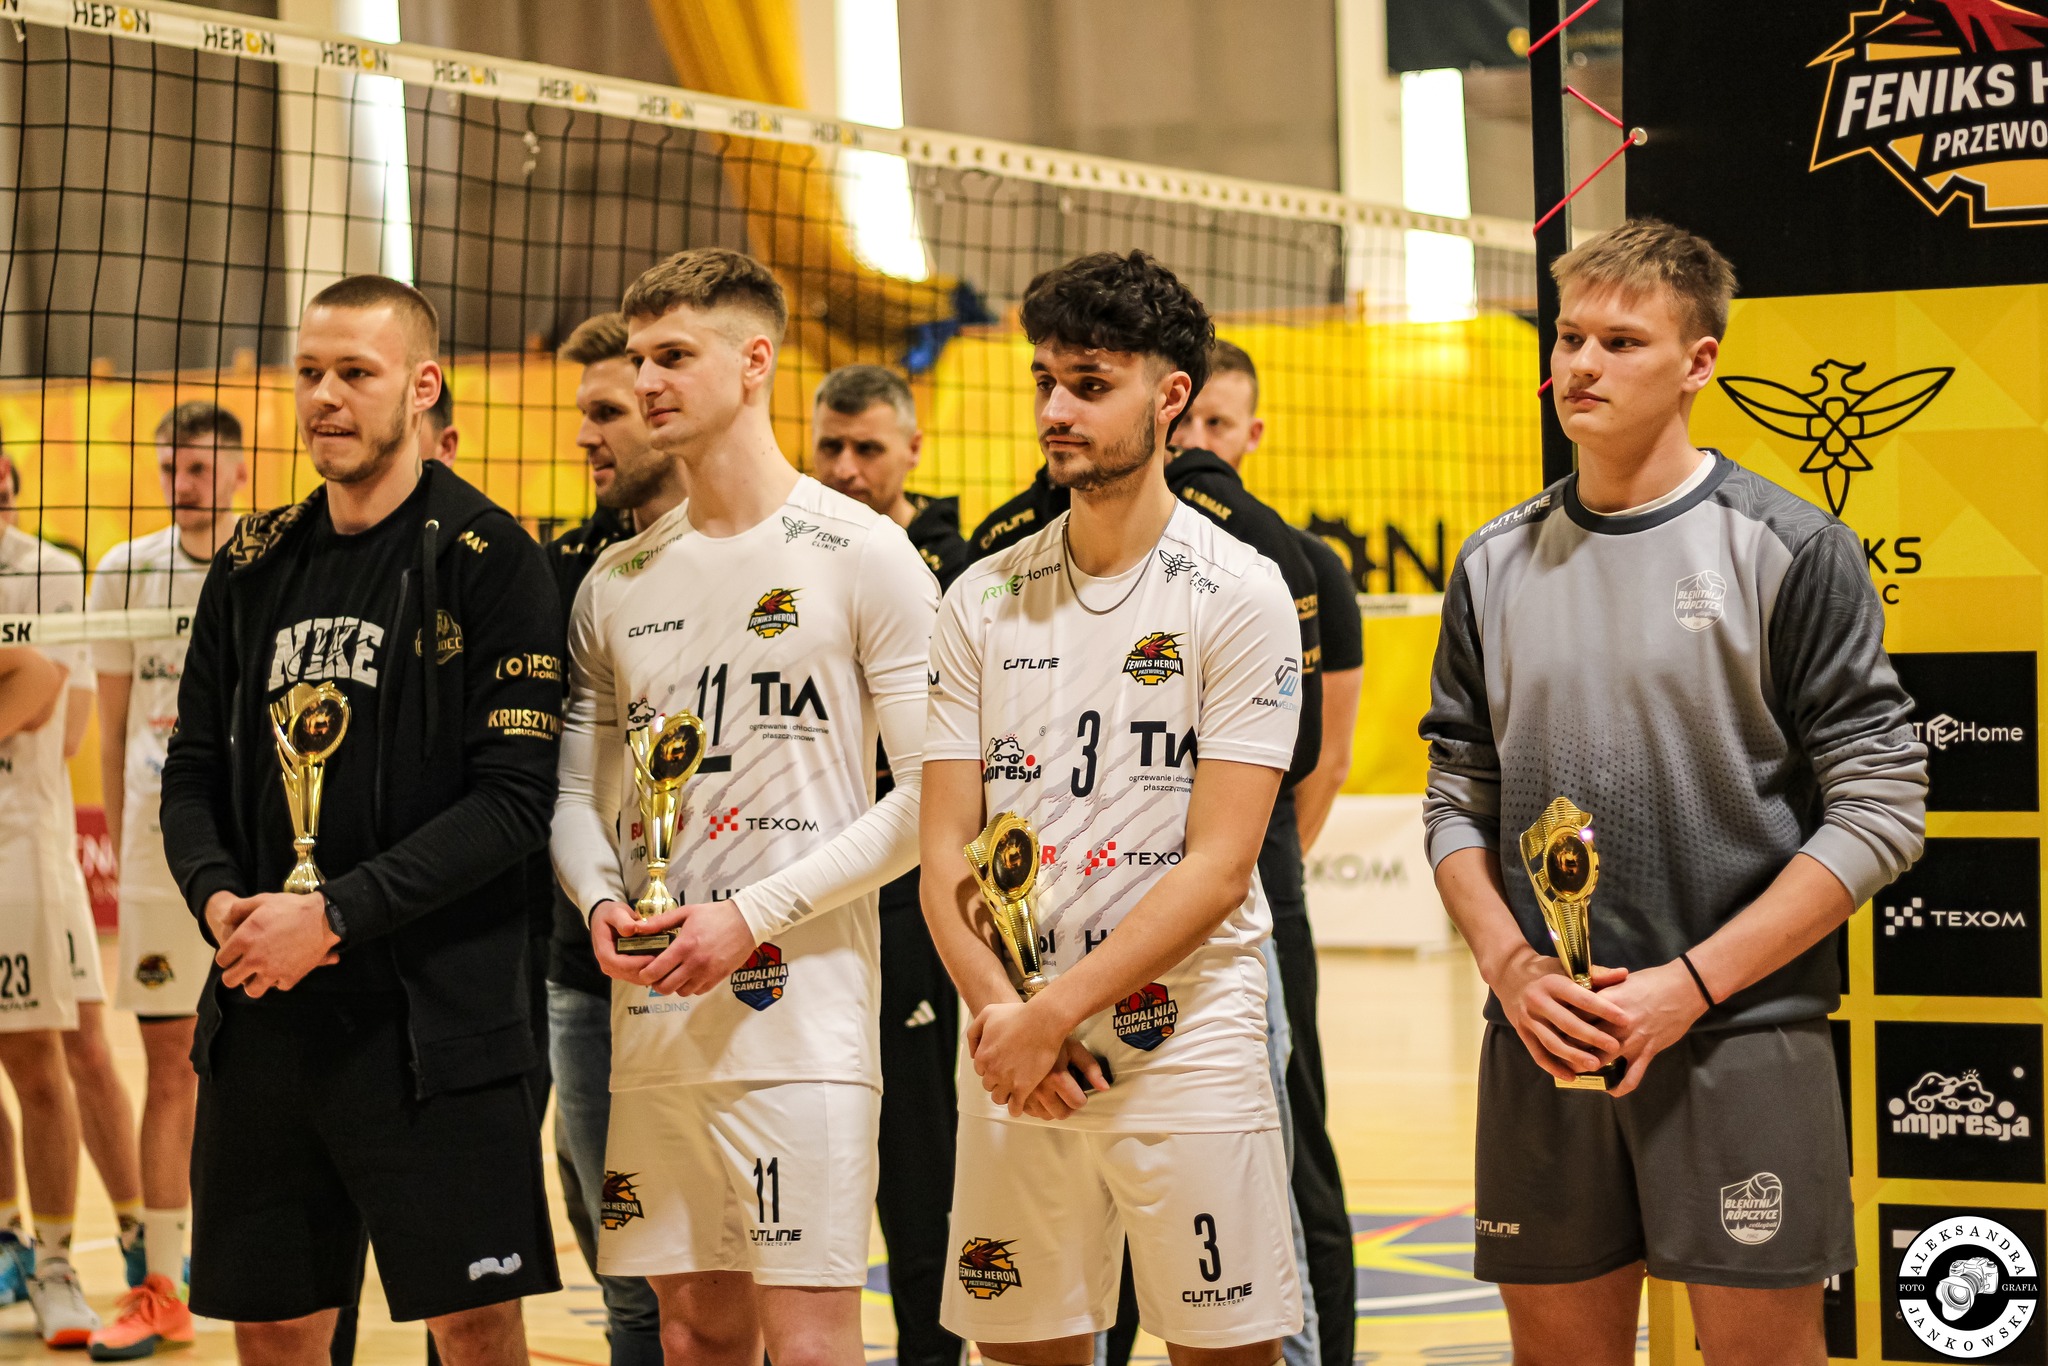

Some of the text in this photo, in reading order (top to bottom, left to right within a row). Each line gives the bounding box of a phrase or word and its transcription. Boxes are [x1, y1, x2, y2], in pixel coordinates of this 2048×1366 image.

[73, 1, 151, 33] HERON
[203, 24, 275, 55] HERON
[321, 41, 390, 71] HERON
[1837, 62, 2016, 138] FENIKS
[1932, 119, 2048, 162] PRZEWO
[1480, 494, 1552, 536] CUTLINE
[812, 540, 838, 552] CLINIC
[815, 532, 850, 548] FENIKS
[628, 619, 685, 638] CUTLINE
[749, 614, 773, 628] FENIKS
[773, 612, 797, 625] HERON
[268, 616, 384, 692] NIKE
[1003, 656, 1060, 671] CUTLINE
[1126, 659, 1181, 672] FENIKS HERON
[697, 663, 728, 746] 11
[488, 708, 563, 735] KRUSZYW
[749, 723, 788, 732] ogrzewanie
[762, 732, 816, 743] płaszczyznowe
[1071, 710, 1101, 798] 3
[1129, 773, 1172, 783] ogrzewanie
[746, 817, 820, 833] TEXOM
[1123, 851, 1183, 866] TEXO
[1930, 910, 2026, 928] TEXOM
[732, 964, 788, 983] KOPALNIA
[733, 977, 786, 992] GAWEŁ MAJ
[627, 1002, 690, 1016] TEAMWELDING
[1114, 1002, 1177, 1028] KOPALNIA
[1118, 1015, 1176, 1036] GAWEŁ MAJ
[1889, 1098, 2030, 1141] impresja
[753, 1157, 780, 1223] 11
[611, 1201, 640, 1215] HERON
[1725, 1199, 1770, 1212] BŁĘKITNI
[1475, 1218, 1520, 1235] UTLINE
[1194, 1213, 1222, 1282] 3
[984, 1270, 1018, 1284] HERON
[1182, 1282, 1252, 1303] CUTLINE
[1213, 1297, 1246, 1307] FACTORY
